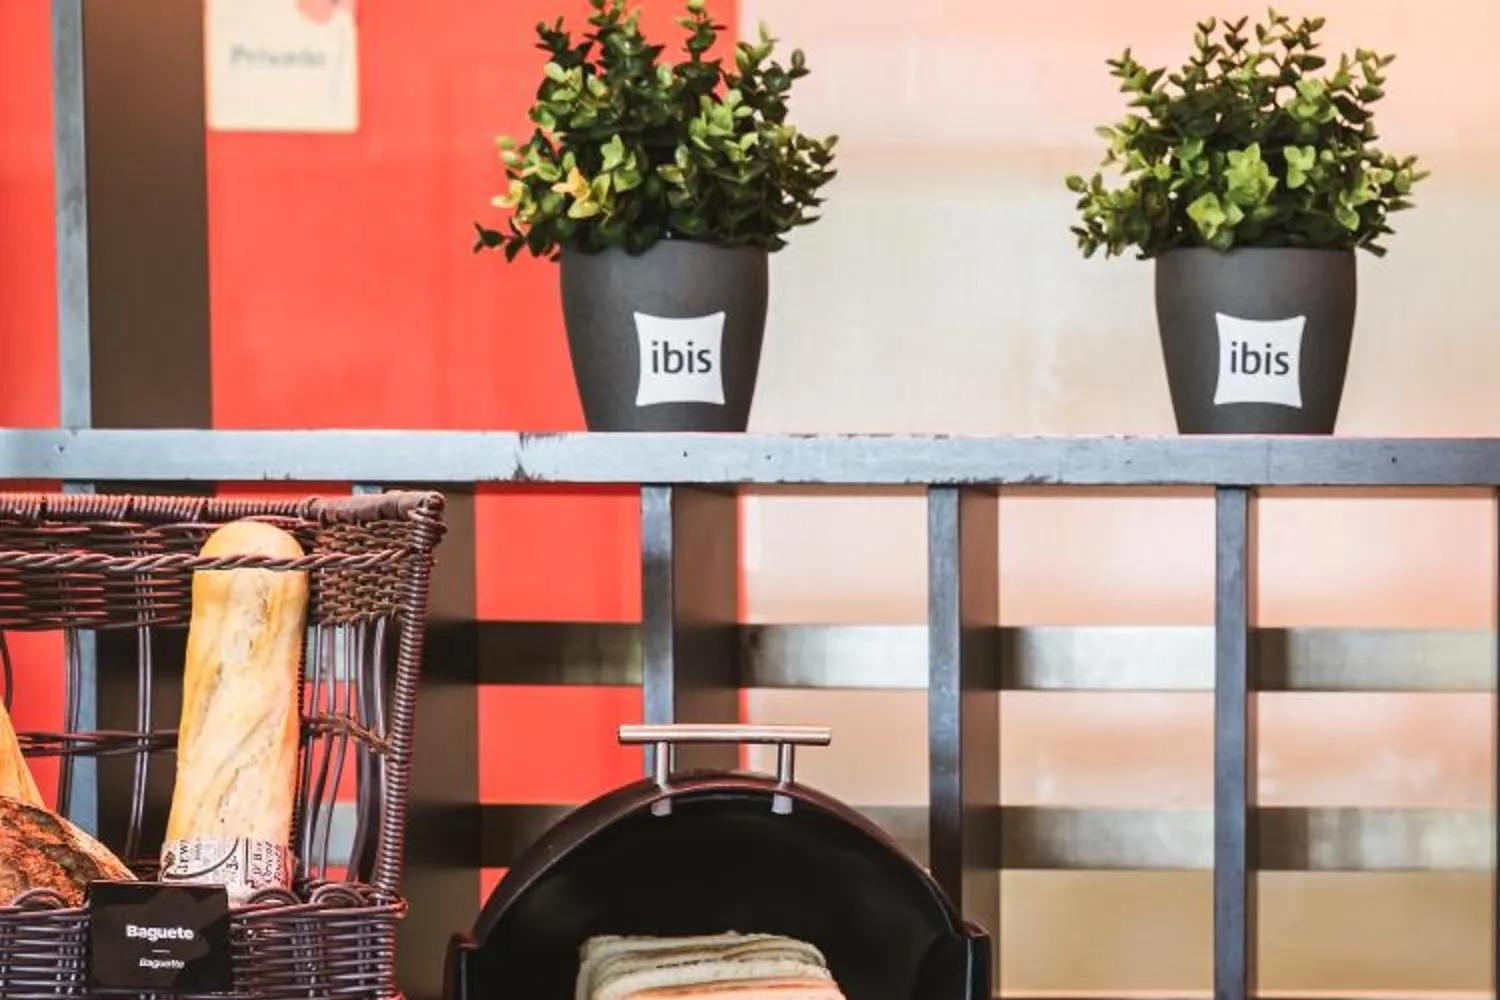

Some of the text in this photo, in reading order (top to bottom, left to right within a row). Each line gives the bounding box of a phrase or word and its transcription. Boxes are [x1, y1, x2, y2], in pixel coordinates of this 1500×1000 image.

[651, 340, 712, 374] ibis
[1230, 341, 1289, 375] ibis
[125, 923, 195, 942] Baguete
